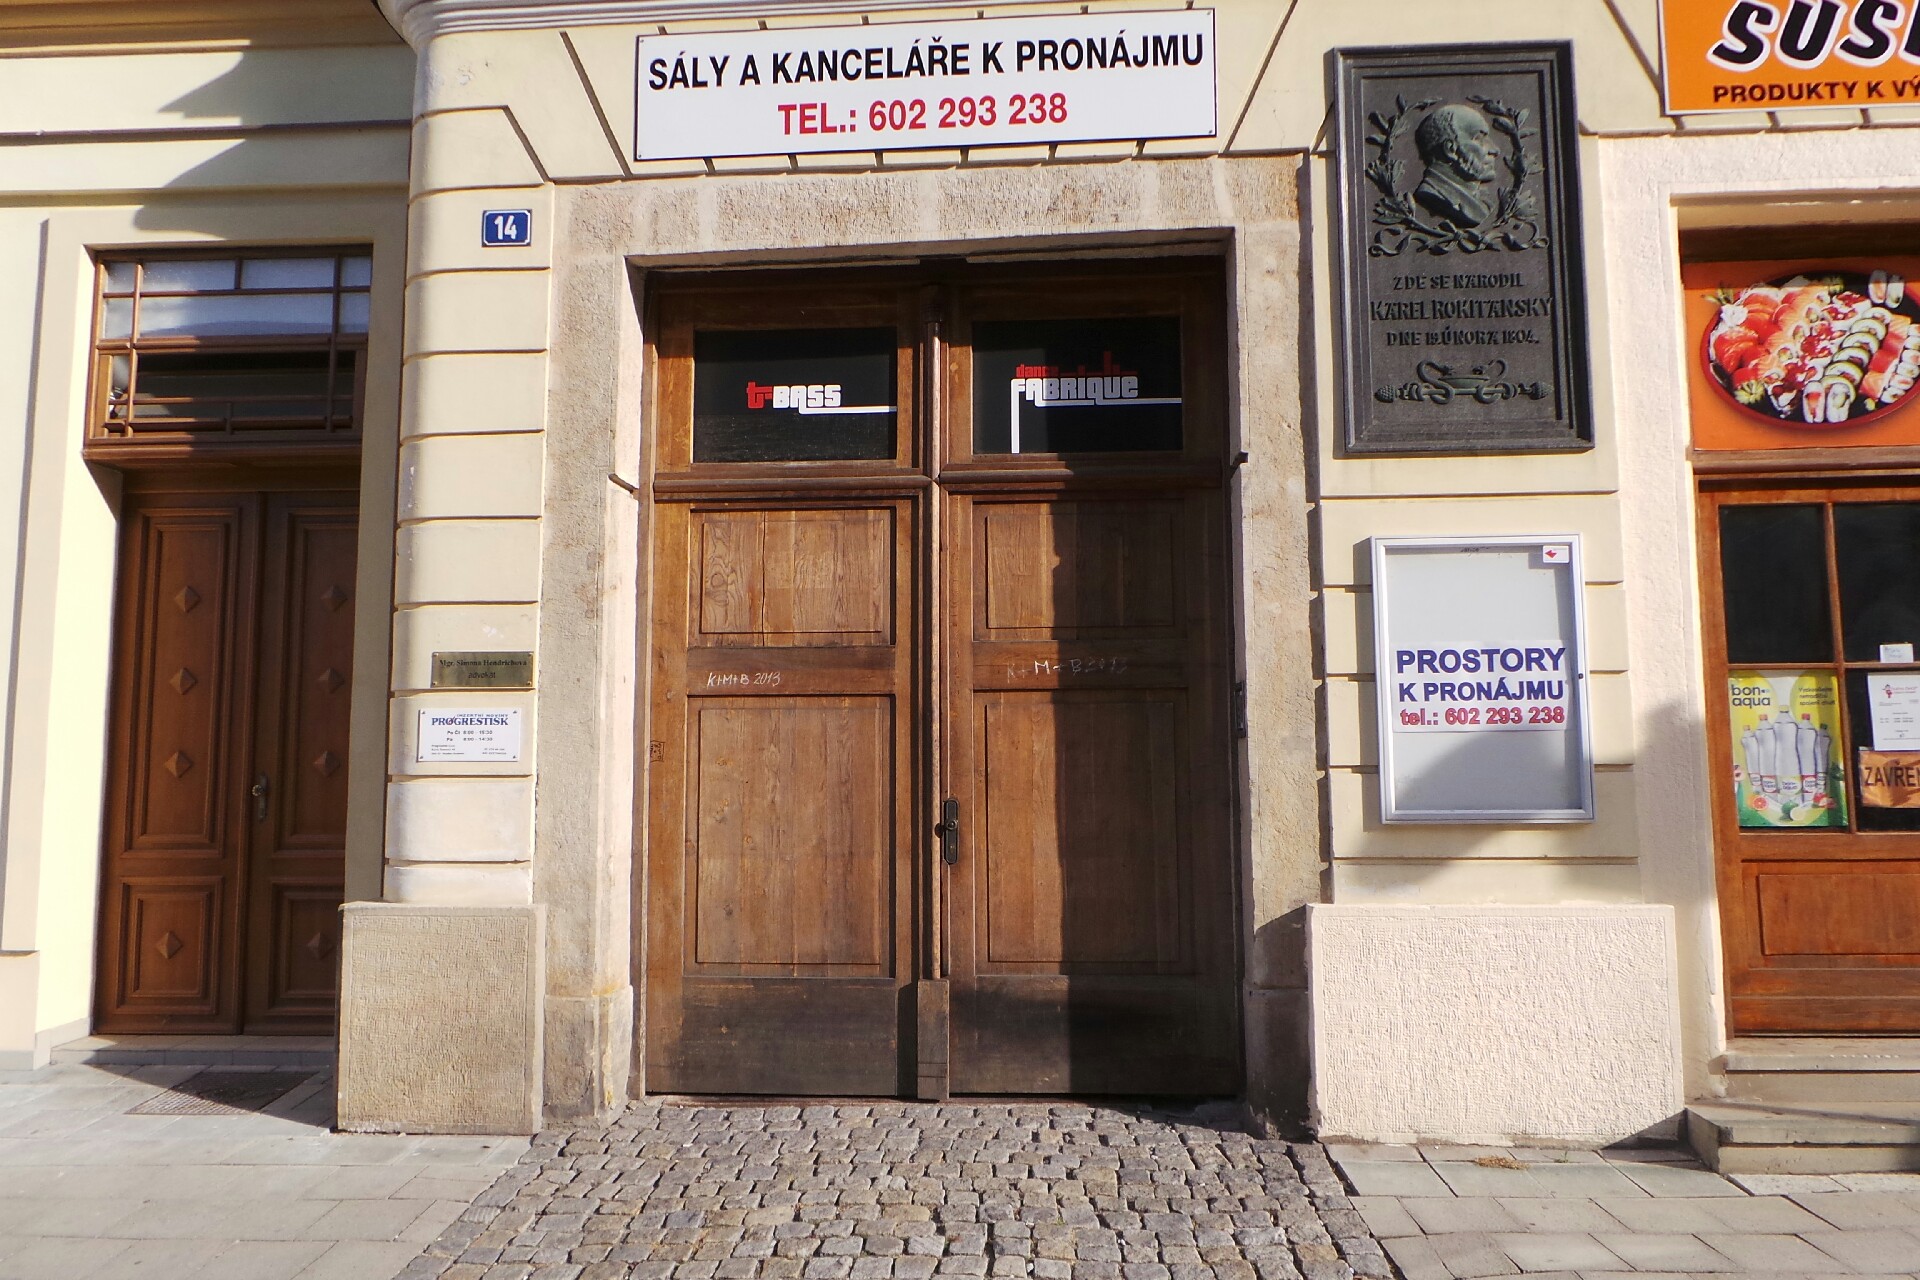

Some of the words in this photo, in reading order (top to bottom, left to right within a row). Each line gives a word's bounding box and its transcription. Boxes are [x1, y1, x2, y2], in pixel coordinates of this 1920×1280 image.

[648, 49, 730, 91] SÁLY
[739, 54, 761, 86] A
[772, 37, 970, 85] KANCELÁŘE
[981, 42, 1005, 75] K
[1016, 29, 1204, 71] PRONÁJMU
[1713, 81, 1859, 103] PRODUKTY
[1867, 80, 1885, 99] K
[778, 103, 857, 135] TEL.:
[868, 98, 927, 131] 602
[938, 96, 997, 128] 293
[1008, 93, 1068, 125] 238
[494, 215, 517, 240] 14
[1393, 275, 1427, 291] ZDE
[1430, 274, 1451, 290] SE
[1453, 272, 1524, 289] NARODIL
[1371, 300, 1430, 321] KAREL
[1387, 331, 1421, 346] DNE
[1396, 648, 1566, 674] PROSTORY
[753, 671, 781, 687] 2013
[1398, 683, 1418, 703] K
[1423, 676, 1564, 702] PRONÁJMU
[1732, 697, 1771, 709] aqua
[431, 717, 509, 726] PROGRESTISK
[1400, 708, 1439, 725] tel.:
[1445, 707, 1481, 725] 602
[1486, 707, 1523, 725] 293
[1528, 706, 1565, 724] 238
[1864, 760, 1920, 787] ZAVŘE
